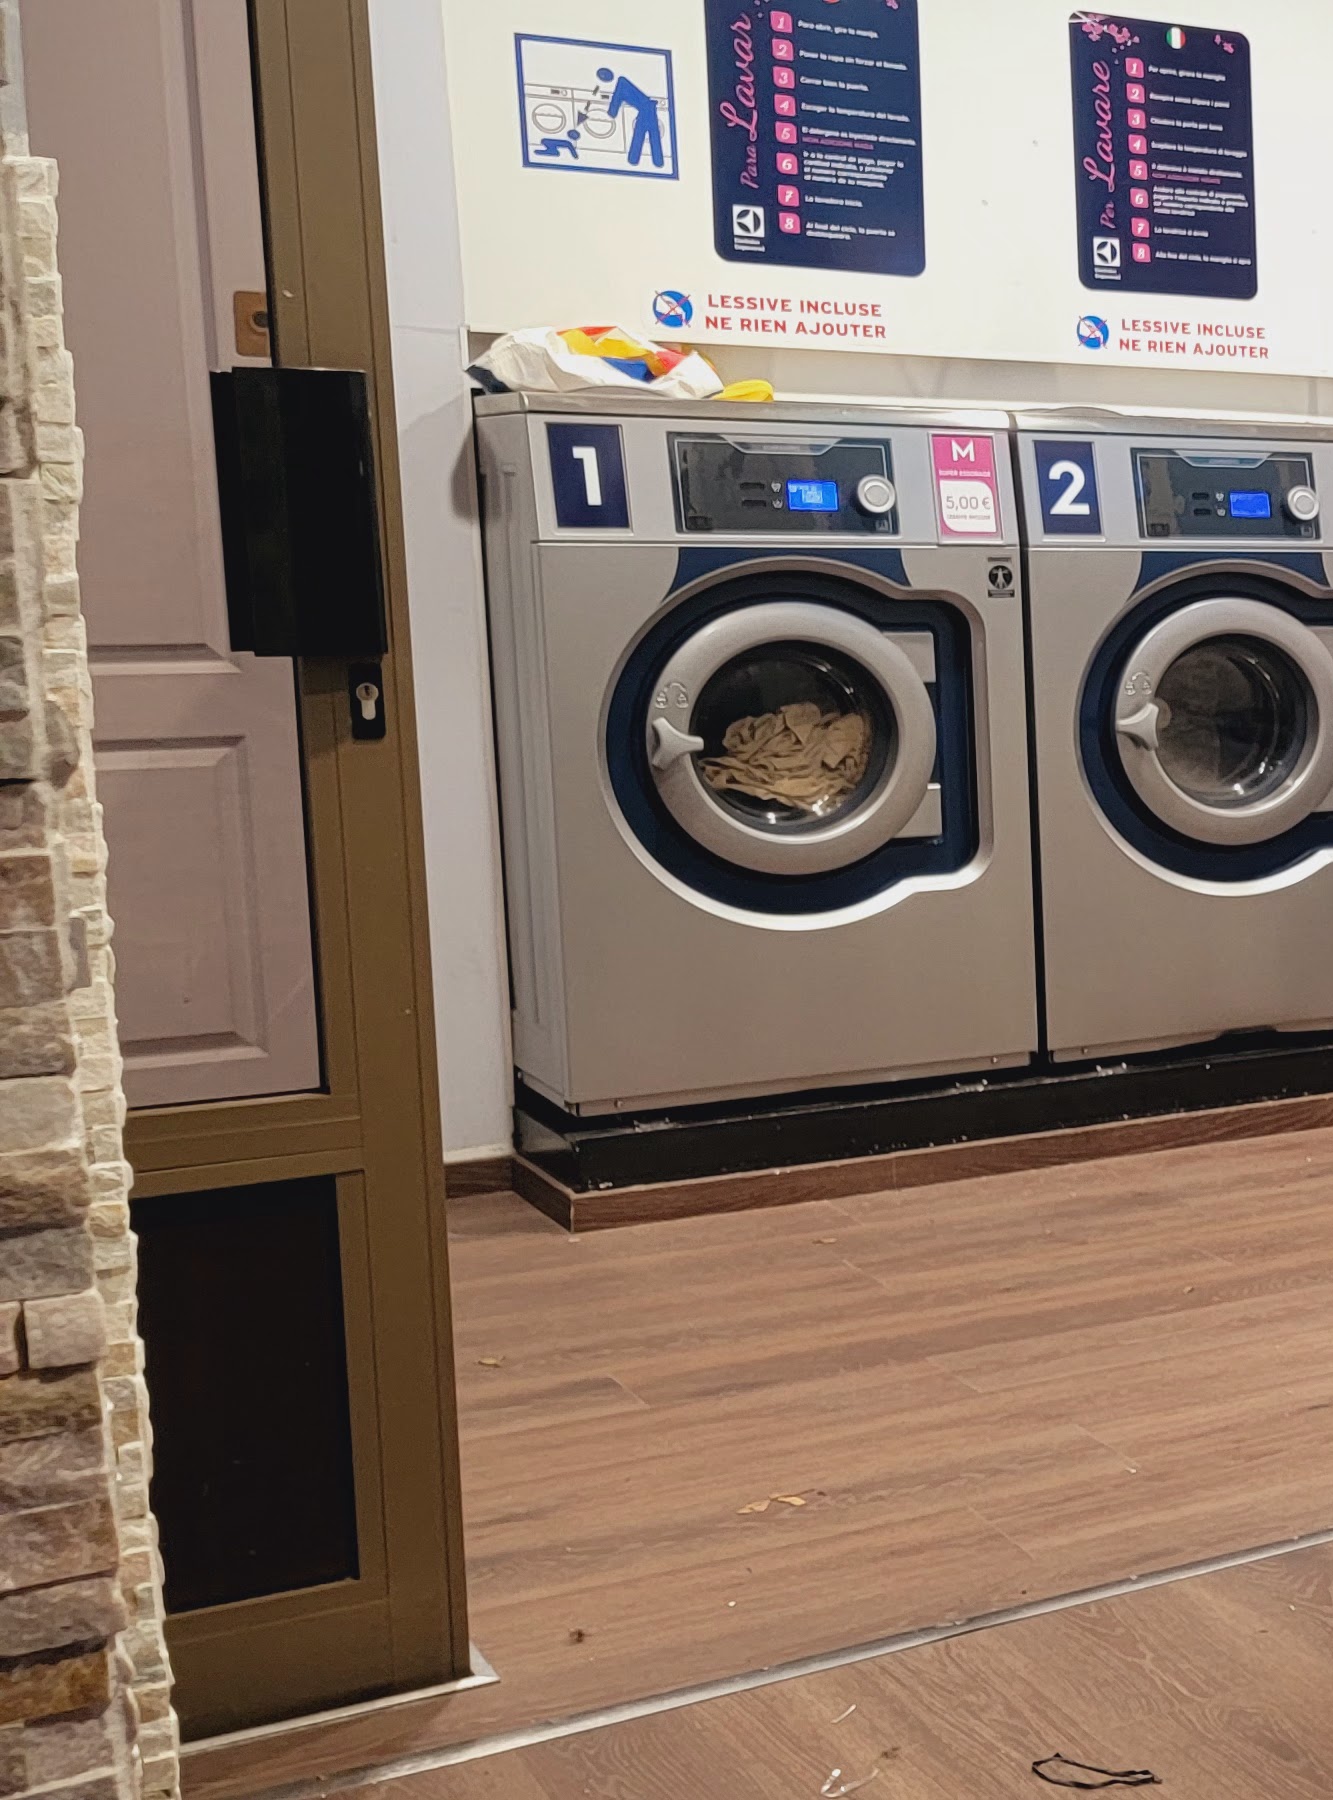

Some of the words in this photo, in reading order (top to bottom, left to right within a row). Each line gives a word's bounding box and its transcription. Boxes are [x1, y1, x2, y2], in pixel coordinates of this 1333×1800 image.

[777, 18, 784, 29] 1
[778, 44, 787, 56] 2
[1130, 63, 1137, 74] 1
[719, 12, 758, 142] Lavar
[780, 72, 788, 84] 3
[1131, 88, 1139, 98] 2
[780, 100, 789, 111] 4
[1132, 114, 1140, 124] 3
[1082, 60, 1116, 193] Lavare
[782, 128, 790, 139] 5
[1133, 139, 1141, 150] 4
[739, 145, 759, 189] Para
[782, 158, 792, 170] 6
[1134, 165, 1142, 176] 5
[785, 190, 793, 203] 7
[1135, 194, 1143, 204] 6
[785, 218, 793, 230] 8
[1137, 222, 1144, 234] 7
[1137, 248, 1145, 259] 8
[708, 294, 792, 312] LESSIVE
[800, 300, 882, 317] INCLUSE
[705, 316, 732, 330] NE
[740, 318, 787, 333] RIEN
[796, 322, 886, 338] AJOUTER
[1122, 318, 1191, 335] LESSIVE
[1198, 324, 1266, 339] INCLUSE
[1119, 339, 1141, 351] NE
[1148, 340, 1186, 354] RIEN
[1193, 343, 1269, 359] AJOUTER
[951, 439, 975, 462] M
[572, 446, 602, 506] 1
[1048, 460, 1091, 515] 2
[946, 496, 978, 511] 5,00
